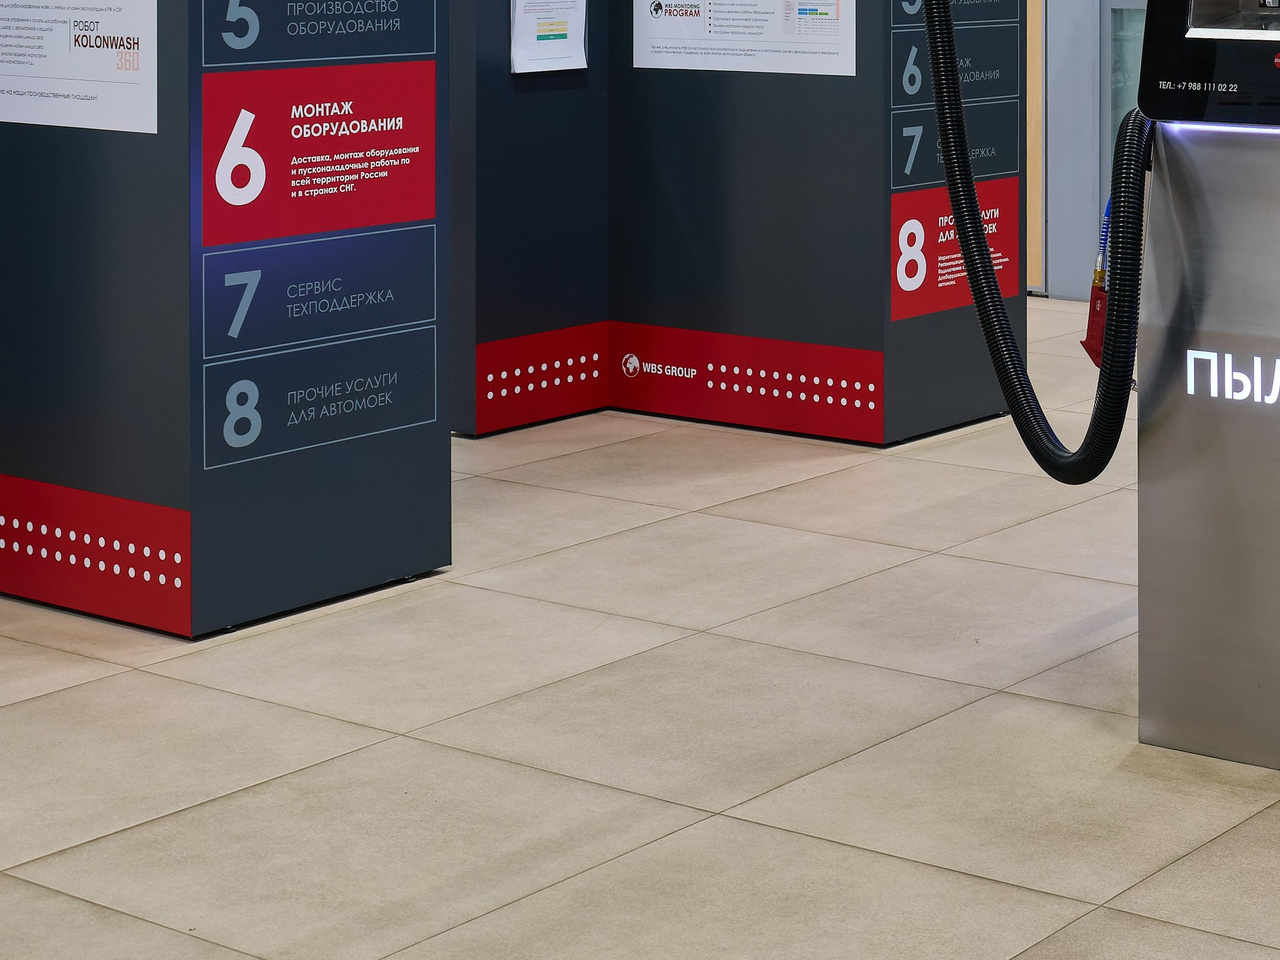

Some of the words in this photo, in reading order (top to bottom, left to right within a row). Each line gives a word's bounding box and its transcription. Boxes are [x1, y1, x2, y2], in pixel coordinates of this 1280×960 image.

[287, 0, 399, 16] ПРОИЗВОДСТВО
[664, 9, 701, 17] PROGRAM
[73, 20, 99, 32] РОБОТ
[287, 18, 400, 35] ОБОРУДОВАНИЯ
[74, 34, 140, 50] KOLONWASH
[116, 51, 139, 71] 360
[902, 45, 922, 95] 6
[959, 69, 1000, 83] УДОВАНИЯ
[1159, 81, 1175, 89] ТЕЛ.:
[1177, 82, 1186, 90] +7
[1188, 82, 1201, 91] 988
[1203, 83, 1216, 91] 111
[1217, 83, 1227, 92] 02
[1228, 84, 1238, 92] 22
[290, 101, 353, 119] МОНТАЖ
[290, 117, 403, 139] ОБОРУДОВАНИЯ
[215, 108, 267, 206] 6
[290, 153, 332, 166] Доставка,
[333, 150, 365, 161] монтаж
[365, 145, 420, 160] оборудования
[902, 125, 923, 176] 7
[297, 161, 369, 176] пусконаладочные
[370, 157, 400, 169] работы
[400, 157, 410, 165] по
[291, 177, 311, 187] всей
[312, 171, 359, 186] территории
[360, 169, 388, 180] России
[291, 190, 297, 198] и
[298, 189, 303, 197] в
[304, 186, 338, 198] странах
[339, 183, 357, 193] СНГ.
[938, 230, 955, 244] ДЛЯ
[896, 218, 927, 292] 8
[287, 277, 342, 299] СЕРВИС
[224, 269, 262, 339] 7
[287, 289, 394, 318] ТЕХПОДДЕРЖКА
[642, 361, 663, 375] WBS
[665, 365, 697, 379] GROUP
[287, 382, 342, 405] ПРОЧИЕ
[345, 372, 398, 394] УСЛУГИ
[223, 379, 262, 448] 8
[287, 406, 315, 427] ДЛЯ
[319, 391, 393, 419] АВТОМОЕК
